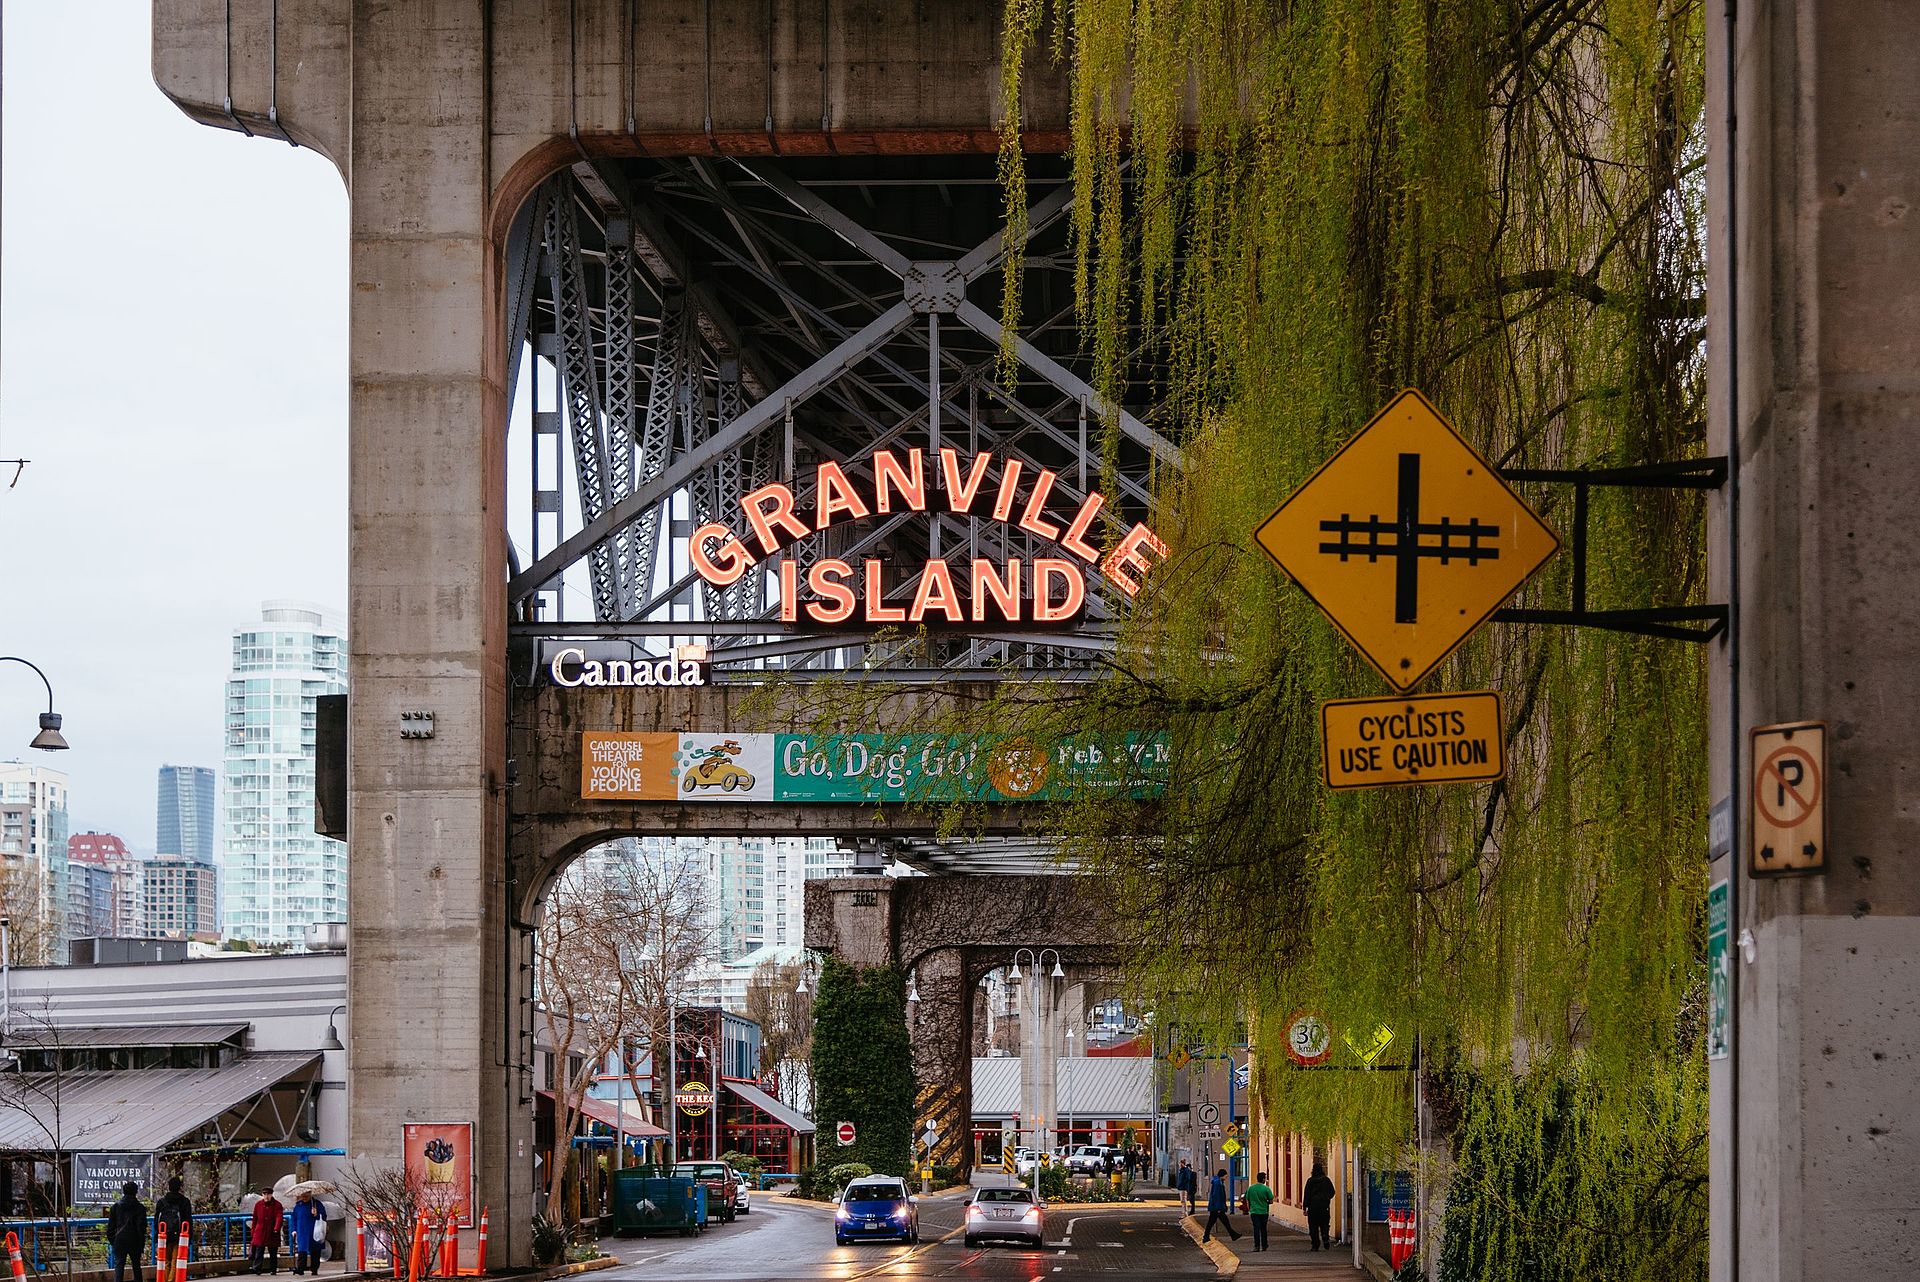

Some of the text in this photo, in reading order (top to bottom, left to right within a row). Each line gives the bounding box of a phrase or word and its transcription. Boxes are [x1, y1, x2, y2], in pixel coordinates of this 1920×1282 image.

[689, 447, 1171, 597] GRANVILLE
[780, 558, 1086, 622] ISLAND
[551, 648, 705, 687] Canada
[1359, 710, 1465, 741] CYCLISTS
[590, 740, 643, 752] CAROUSEL
[592, 750, 642, 762] THEATRE
[1058, 744, 1102, 765] Feb
[1340, 739, 1487, 773] USE CAUTION
[612, 760, 628, 768] FOR
[783, 740, 833, 780] Go,
[842, 741, 912, 788] Dog.
[921, 740, 978, 780] Go!
[592, 766, 641, 780] YOUNG
[590, 778, 641, 792] PEOPLE
[675, 1094, 695, 1104] THE
[86, 1168, 141, 1177] VANCOUVER
[79, 1179, 145, 1190] FISH COMPNY
